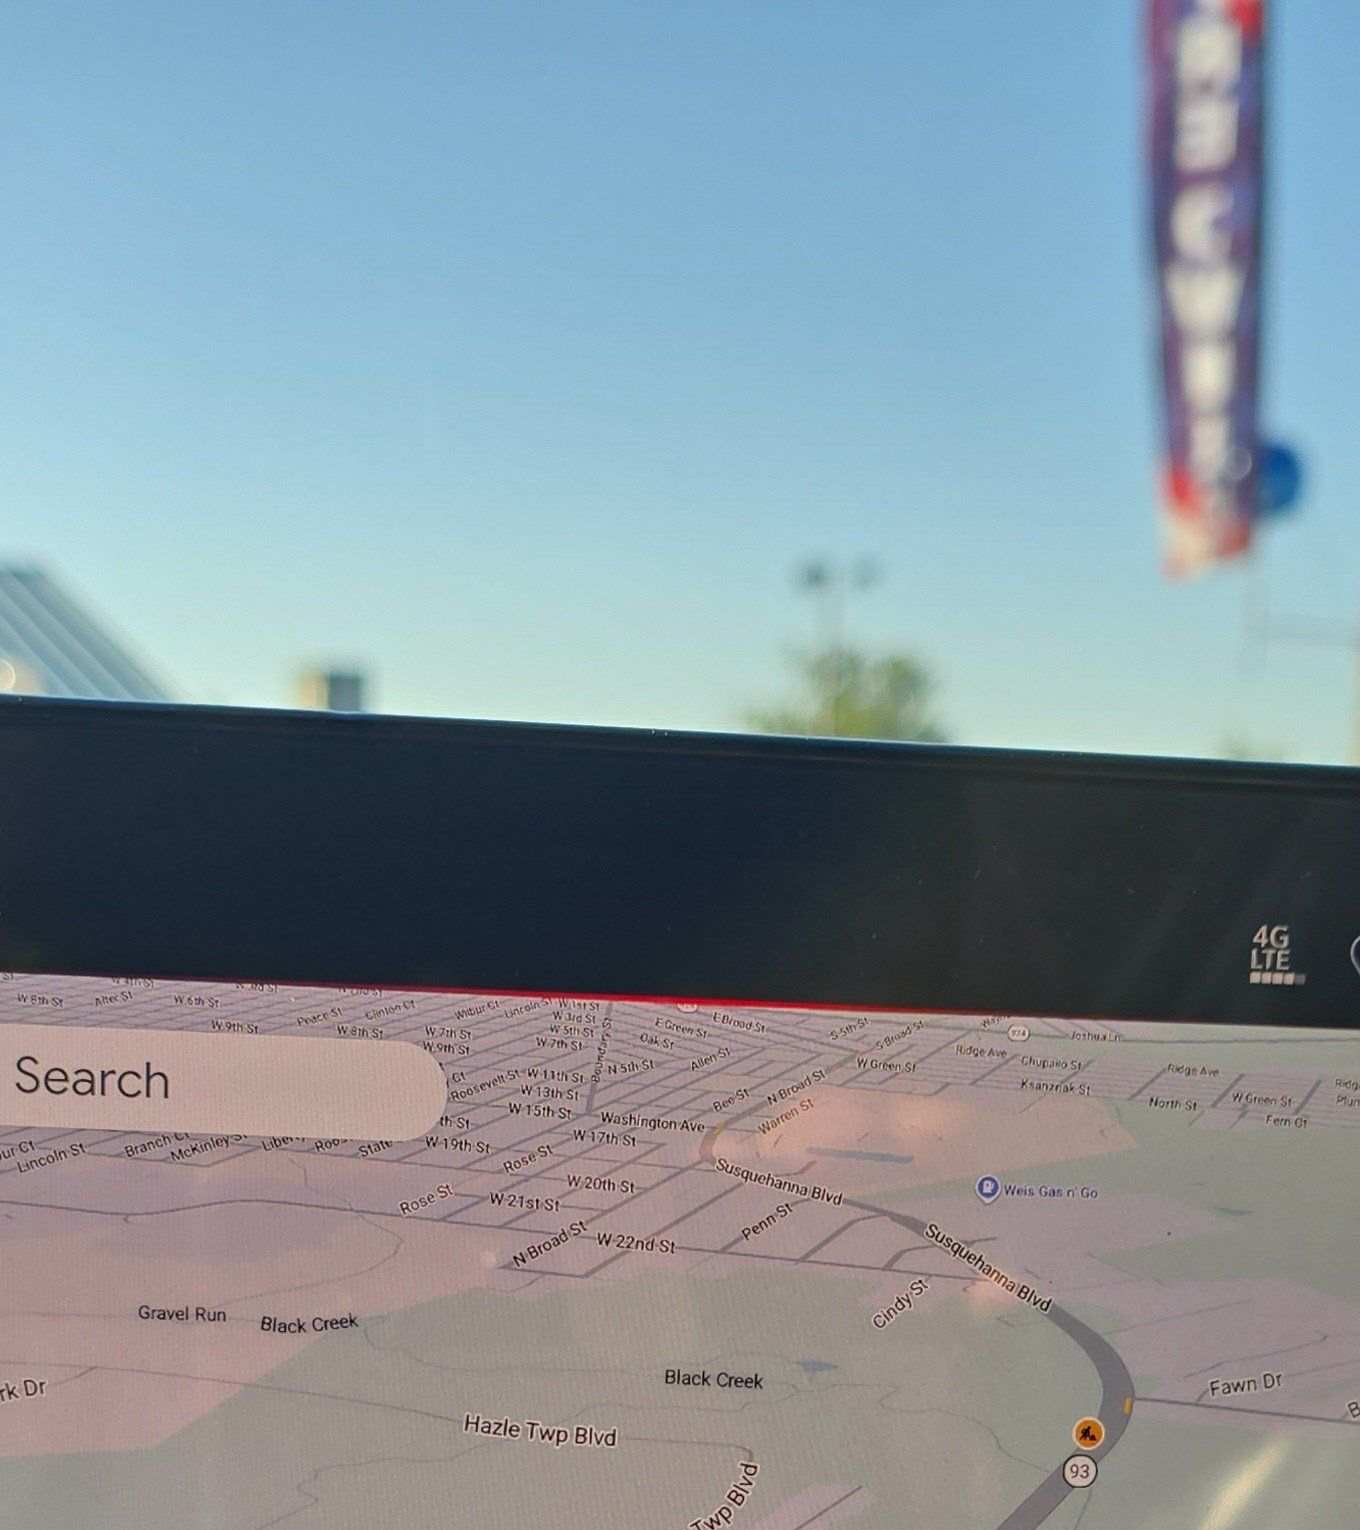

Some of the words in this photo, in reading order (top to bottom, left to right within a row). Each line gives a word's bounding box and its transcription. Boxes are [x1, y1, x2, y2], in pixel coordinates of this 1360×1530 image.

[1253, 924, 1290, 948] 4G
[1251, 948, 1290, 970] LTE
[691, 1055, 717, 1072] Allen
[719, 1046, 731, 1059] St
[955, 1045, 985, 1057] Ridge
[990, 1049, 1008, 1059] Ave
[608, 1065, 617, 1075] N
[620, 1062, 639, 1073] 5th
[641, 1059, 655, 1071] St
[856, 1058, 867, 1068] W
[870, 1059, 901, 1071] Green
[904, 1062, 916, 1073] St
[1167, 1064, 1197, 1076] Ridge
[1200, 1066, 1219, 1077] Ave
[15, 1055, 169, 1099] Search
[450, 1073, 505, 1101] Roosevelt
[507, 1069, 519, 1080] St
[767, 1094, 779, 1105] N
[780, 1076, 810, 1099] Broad
[812, 1069, 826, 1081] St
[521, 1085, 532, 1095] W
[537, 1087, 563, 1098] 13th
[566, 1089, 579, 1101] St
[713, 1096, 734, 1112] Bee
[736, 1089, 749, 1101] St
[1150, 1097, 1181, 1109] North
[1184, 1099, 1197, 1111] St
[509, 1102, 521, 1115] W
[526, 1104, 554, 1117] 15th
[558, 1107, 571, 1119] St
[601, 1111, 676, 1130] Washington
[680, 1120, 704, 1132] Ave
[758, 1106, 795, 1134] Warren
[799, 1097, 812, 1112] St
[19, 1140, 35, 1153] Ct
[125, 1133, 171, 1158] Branch
[171, 1135, 230, 1162] McKinley
[425, 1136, 439, 1148] W
[444, 1139, 471, 1151] 19th
[476, 1141, 490, 1154] St
[573, 1130, 585, 1141] W
[590, 1131, 619, 1144] 17th
[622, 1135, 636, 1147] St
[17, 1150, 68, 1173] Lincoln
[71, 1142, 86, 1155] St
[503, 1152, 537, 1173] Rose
[538, 1144, 553, 1156] St
[567, 1175, 580, 1187] W
[585, 1177, 616, 1191] 20th
[620, 1180, 635, 1194] St
[716, 1158, 808, 1196] Susquehanna
[811, 1186, 843, 1205] Blvd
[1004, 1184, 1034, 1196] Weis
[1040, 1185, 1062, 1197] Gas
[1081, 1187, 1098, 1198] Go
[399, 1194, 435, 1216] Rose
[437, 1183, 454, 1199] St
[490, 1192, 504, 1205] W
[507, 1194, 539, 1209] 21st
[544, 1198, 560, 1212] St
[742, 1215, 776, 1240] Penn
[776, 1203, 793, 1218] St
[513, 1255, 526, 1267] N
[527, 1229, 569, 1259] Broad
[570, 1220, 587, 1236] St
[597, 1233, 612, 1246] W
[617, 1235, 654, 1251] 22nd
[659, 1239, 675, 1254] St
[926, 1224, 1015, 1292] Susquehanna
[1017, 1285, 1052, 1312] Blvd
[138, 1305, 189, 1322] Gravel
[195, 1307, 227, 1322] Run
[873, 1292, 913, 1329] Cindy
[909, 1279, 929, 1296] St
[261, 1316, 307, 1334] Black
[312, 1313, 359, 1331] Creek
[24, 1379, 47, 1396] Dr
[665, 1370, 711, 1387] Black
[716, 1372, 764, 1389] Creek
[1210, 1378, 1257, 1397] Fawn
[1263, 1373, 1282, 1388] Dr
[465, 1414, 519, 1438] Hazle
[526, 1421, 568, 1446] Twp
[575, 1428, 617, 1447] Blvd
[1070, 1464, 1089, 1478] 93
[726, 1462, 759, 1507] Blvd
